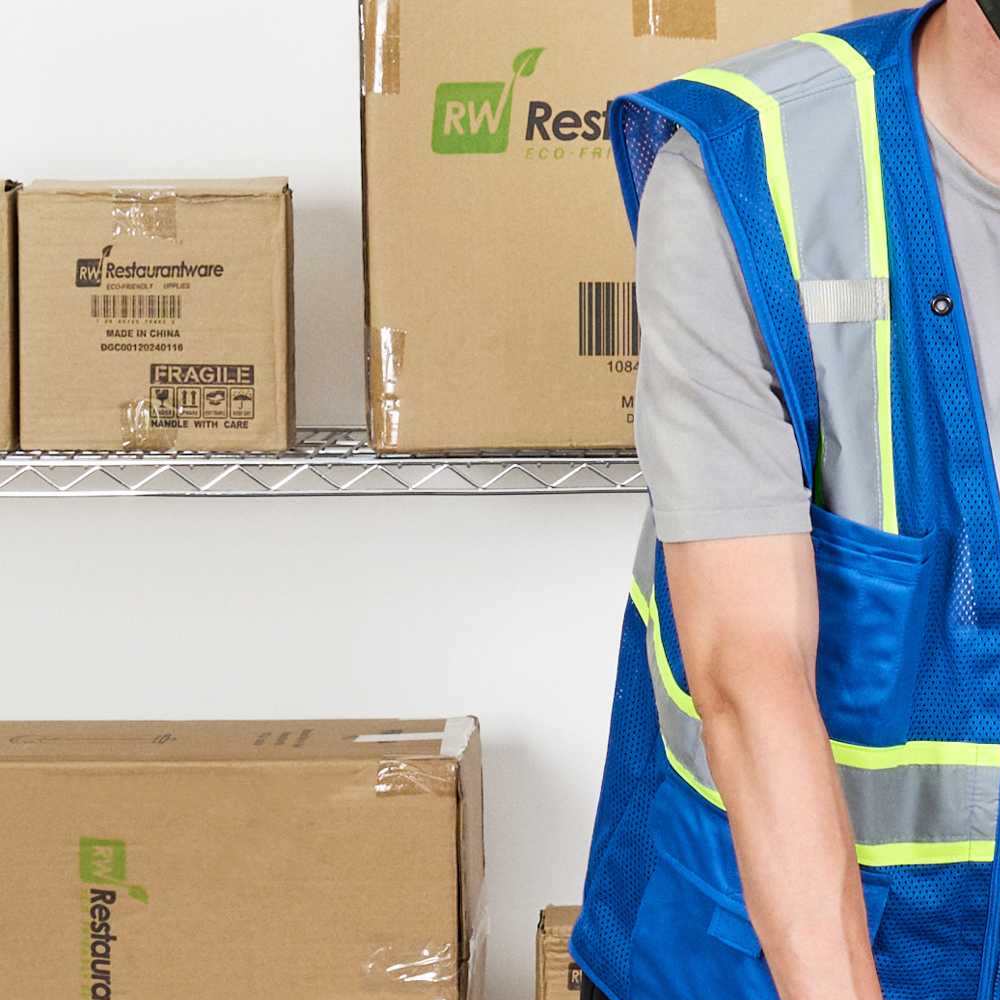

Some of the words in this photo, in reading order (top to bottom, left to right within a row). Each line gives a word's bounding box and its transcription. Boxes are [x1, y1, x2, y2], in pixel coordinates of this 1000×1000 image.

[444, 100, 503, 135] RW
[79, 266, 101, 281] RW
[106, 261, 224, 279] Restaurantware
[106, 329, 134, 338] MADE
[137, 329, 147, 338] IN
[149, 329, 181, 338] CHINA
[154, 364, 251, 384] FRAGILE
[151, 420, 189, 429] HANDLE
[194, 420, 218, 429] WITH
[224, 420, 249, 429] CARE
[91, 846, 114, 881] RW
